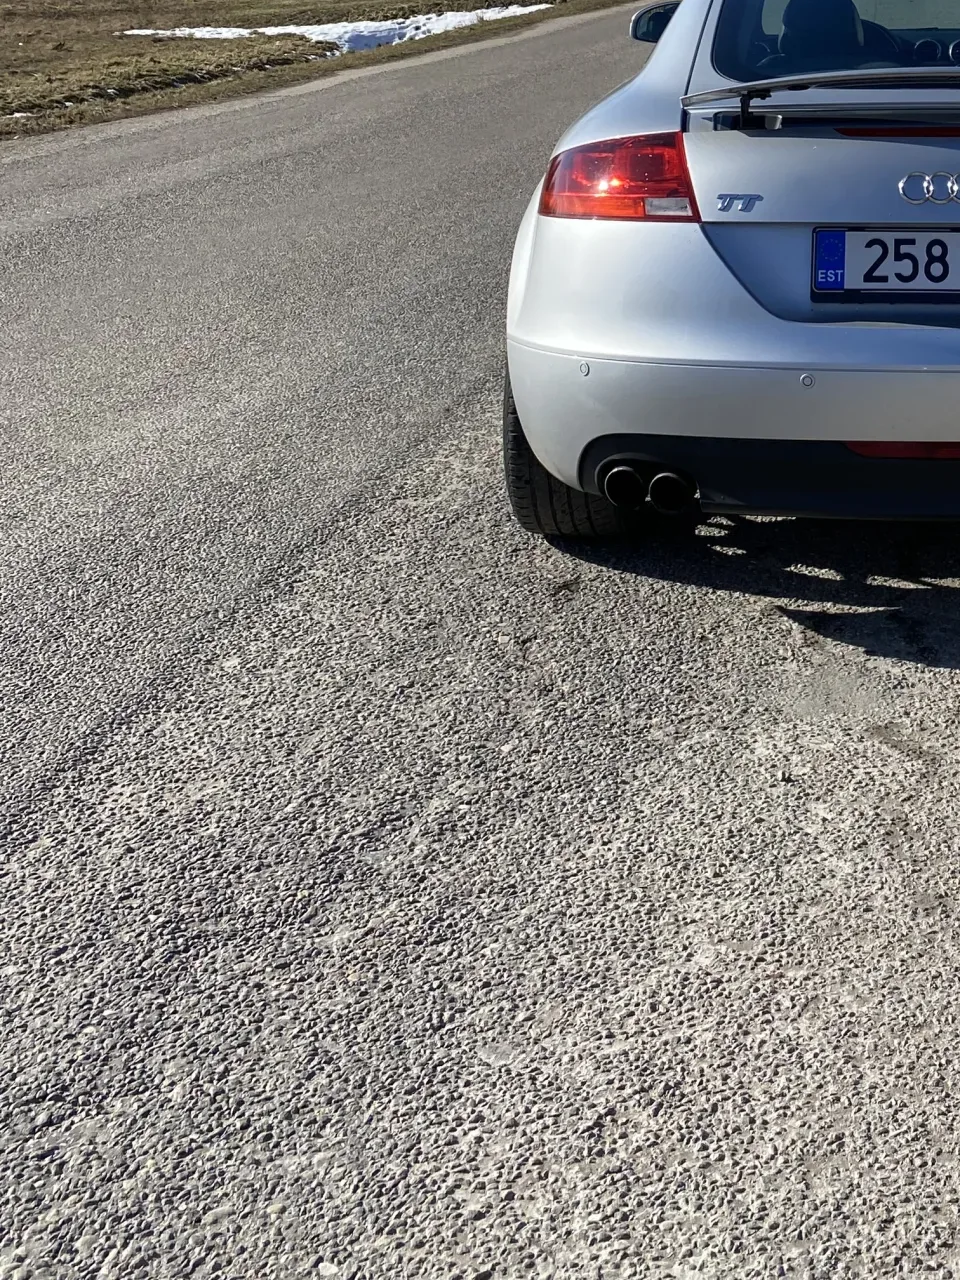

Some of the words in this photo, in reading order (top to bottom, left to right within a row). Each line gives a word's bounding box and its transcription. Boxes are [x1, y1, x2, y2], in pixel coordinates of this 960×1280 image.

[717, 193, 764, 212] TT
[818, 270, 844, 282] EST
[863, 238, 950, 283] 258
